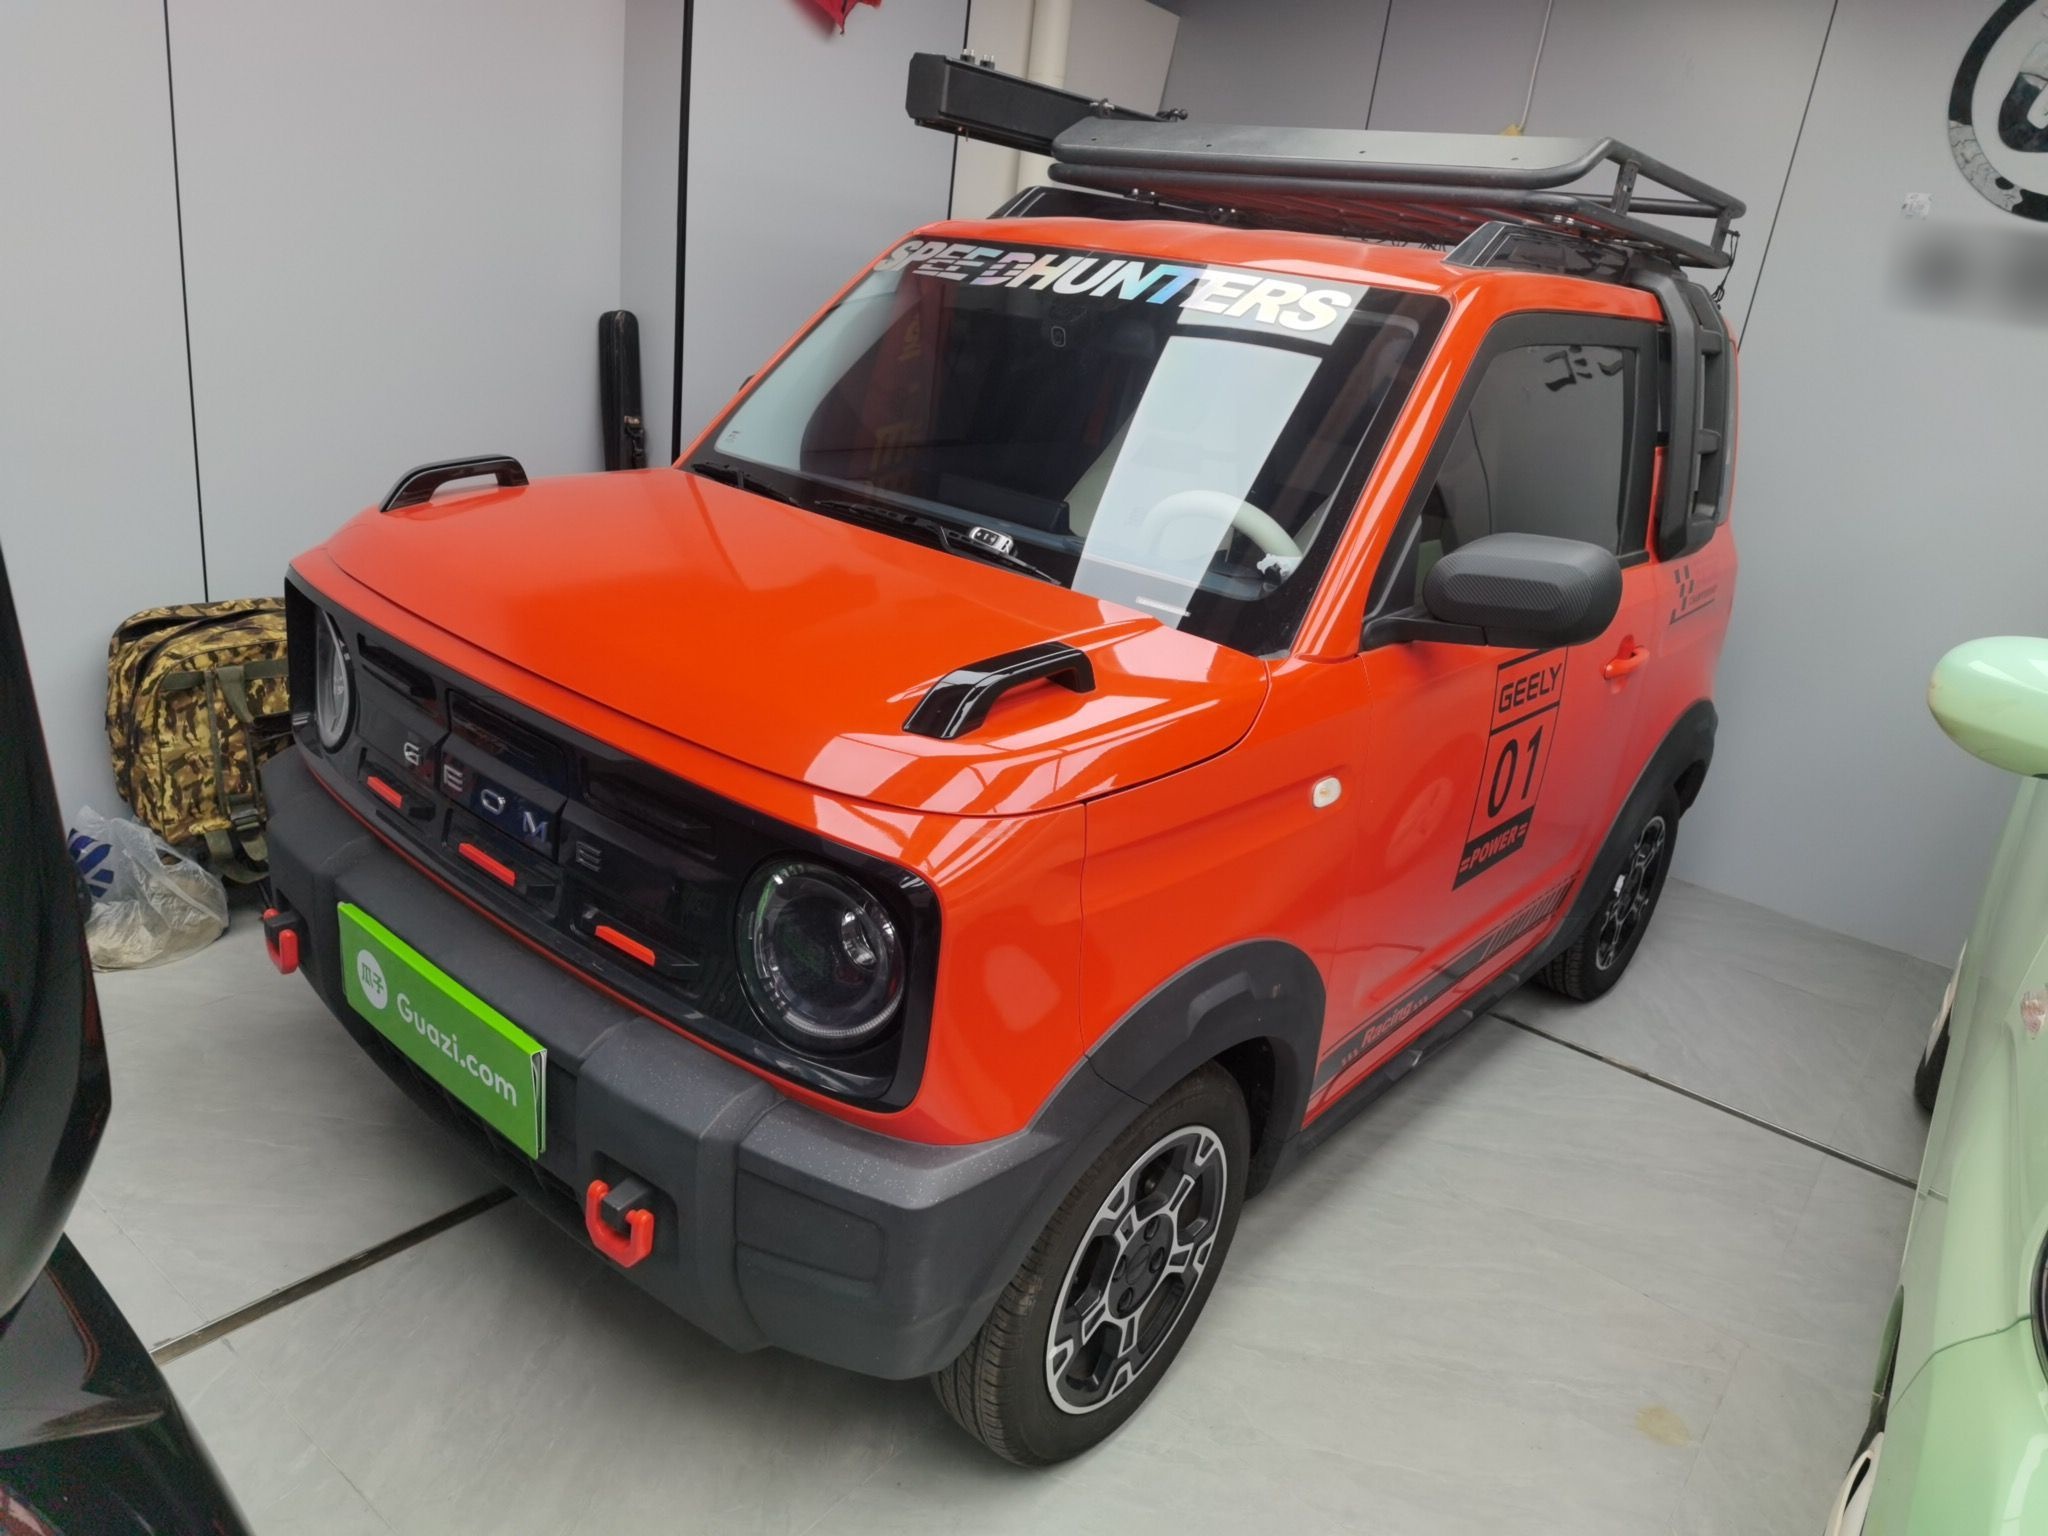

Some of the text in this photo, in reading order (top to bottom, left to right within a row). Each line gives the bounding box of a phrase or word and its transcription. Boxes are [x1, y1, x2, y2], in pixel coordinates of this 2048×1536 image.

[875, 239, 1353, 331] SPEEDHUNTERS
[1498, 662, 1563, 714] GEELY
[1487, 725, 1544, 819] 01
[396, 992, 518, 1107] Guazi.com
